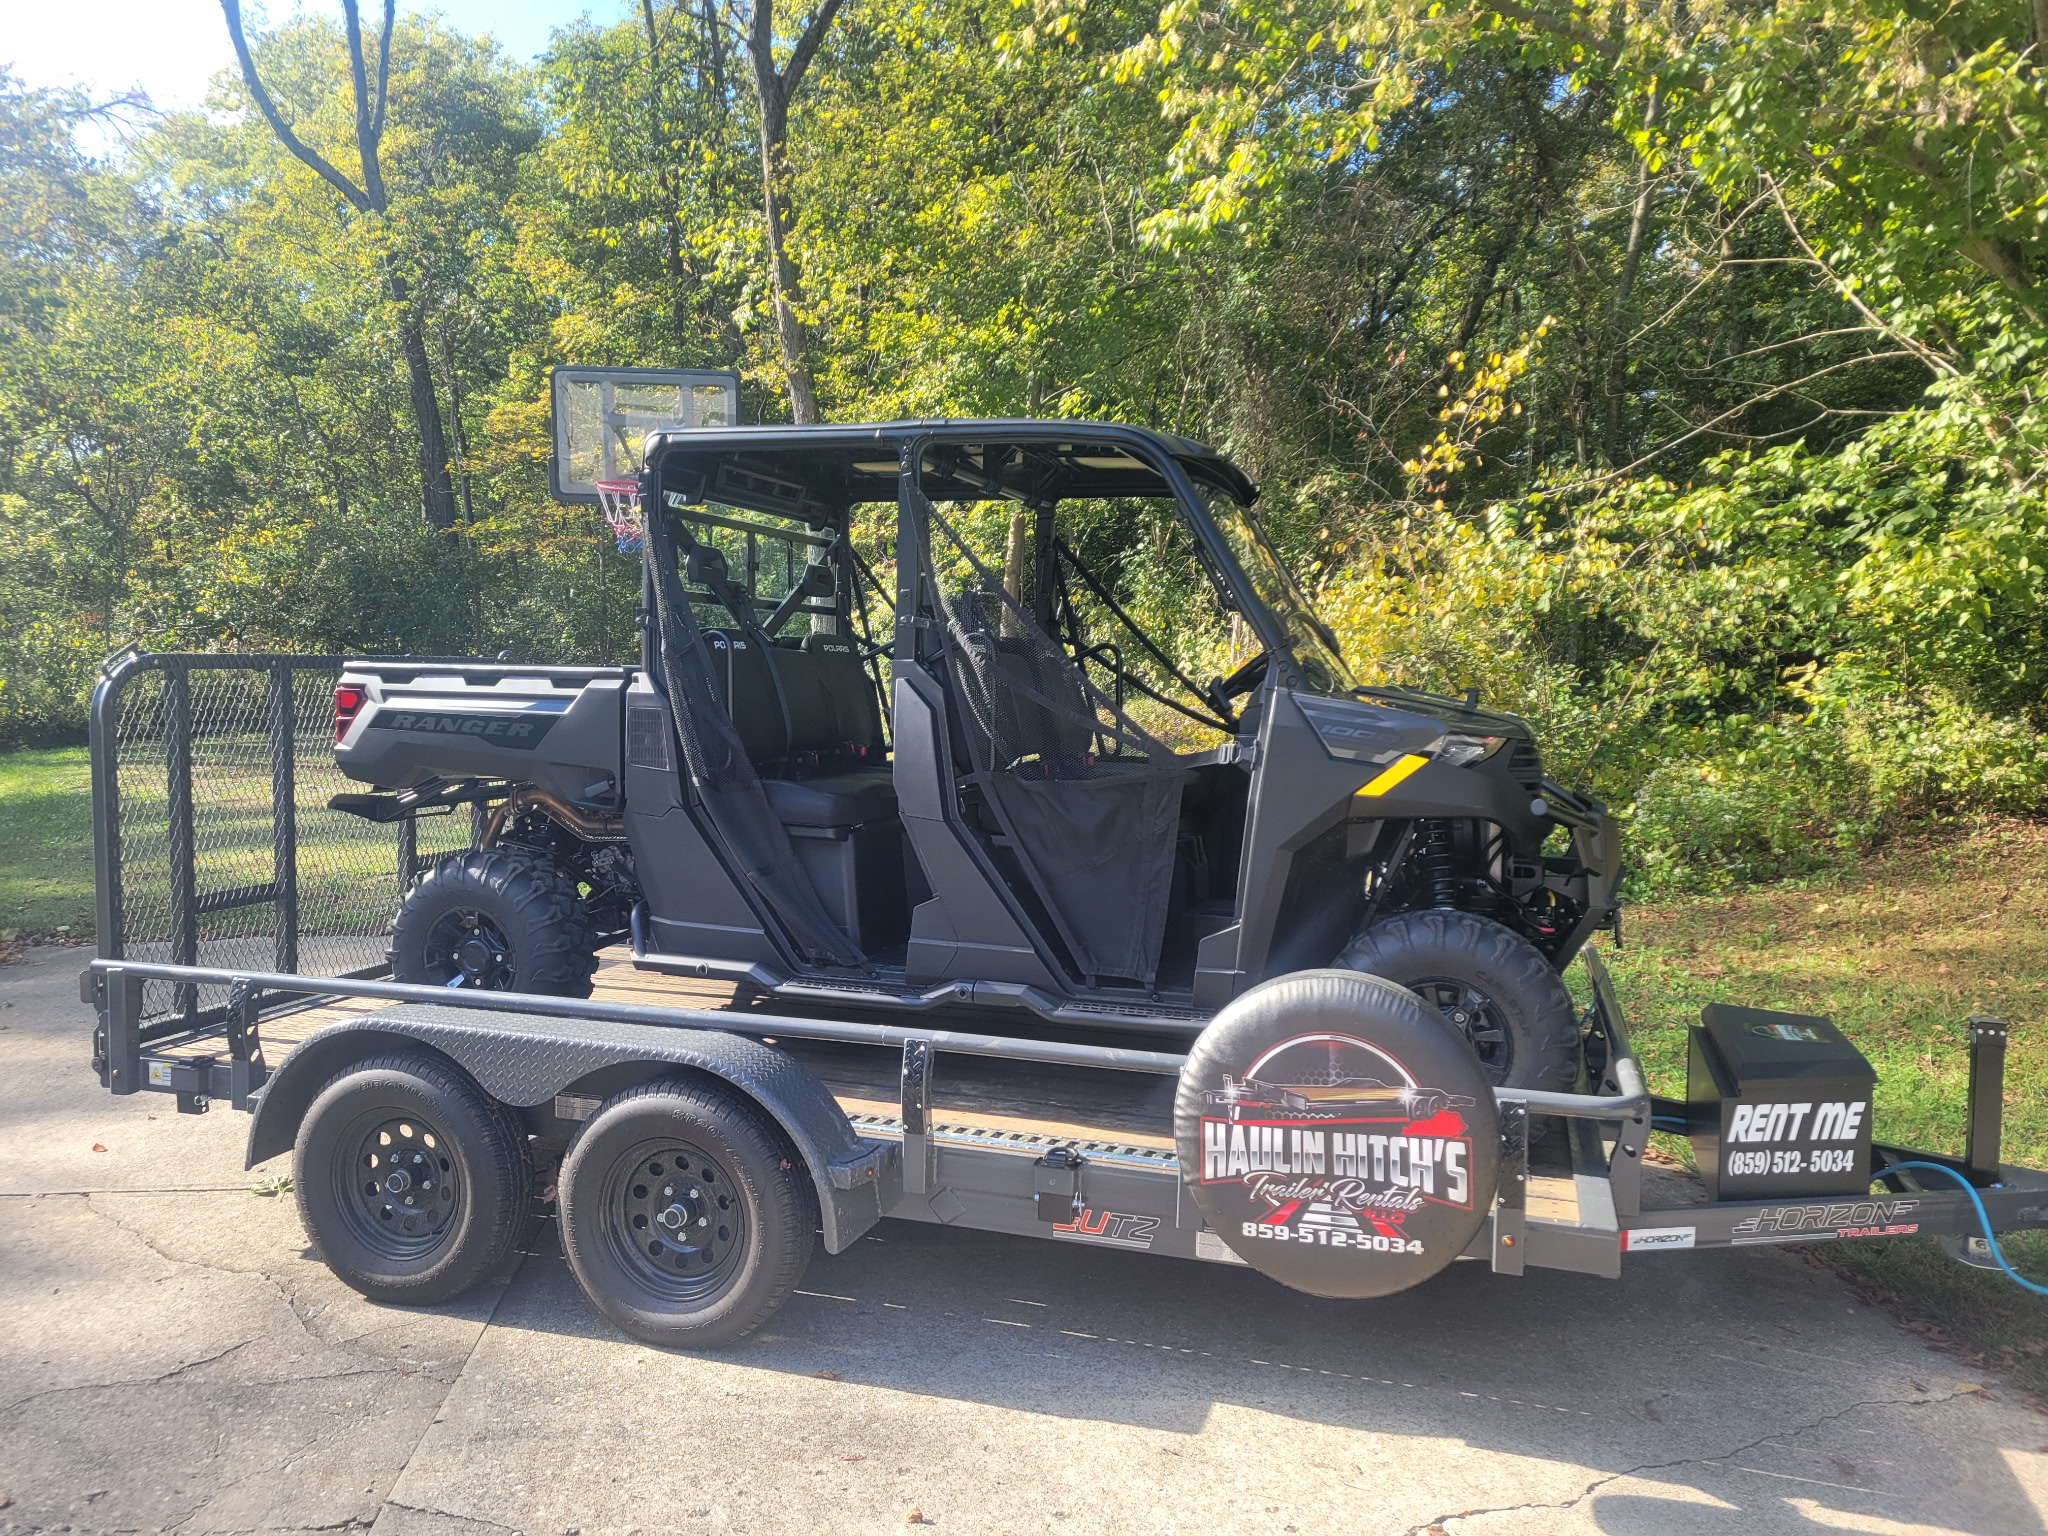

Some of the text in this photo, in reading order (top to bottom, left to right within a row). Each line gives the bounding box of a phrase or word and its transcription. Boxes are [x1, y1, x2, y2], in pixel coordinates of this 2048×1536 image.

[713, 640, 747, 650] PORIS
[390, 714, 535, 738] RANGER
[1727, 1101, 1867, 1142] RENT ME
[1204, 1121, 1468, 1203] HAULIN HITCH'S
[1728, 1149, 1771, 1176] (859)
[1243, 1171, 1426, 1211] Trailer Rentals
[1753, 1201, 1899, 1232] HORIZON
[1837, 1224, 1919, 1238] TRAILERS
[1242, 1221, 1425, 1255] 859-512-5034
[1637, 1234, 1688, 1243] HORIZON
